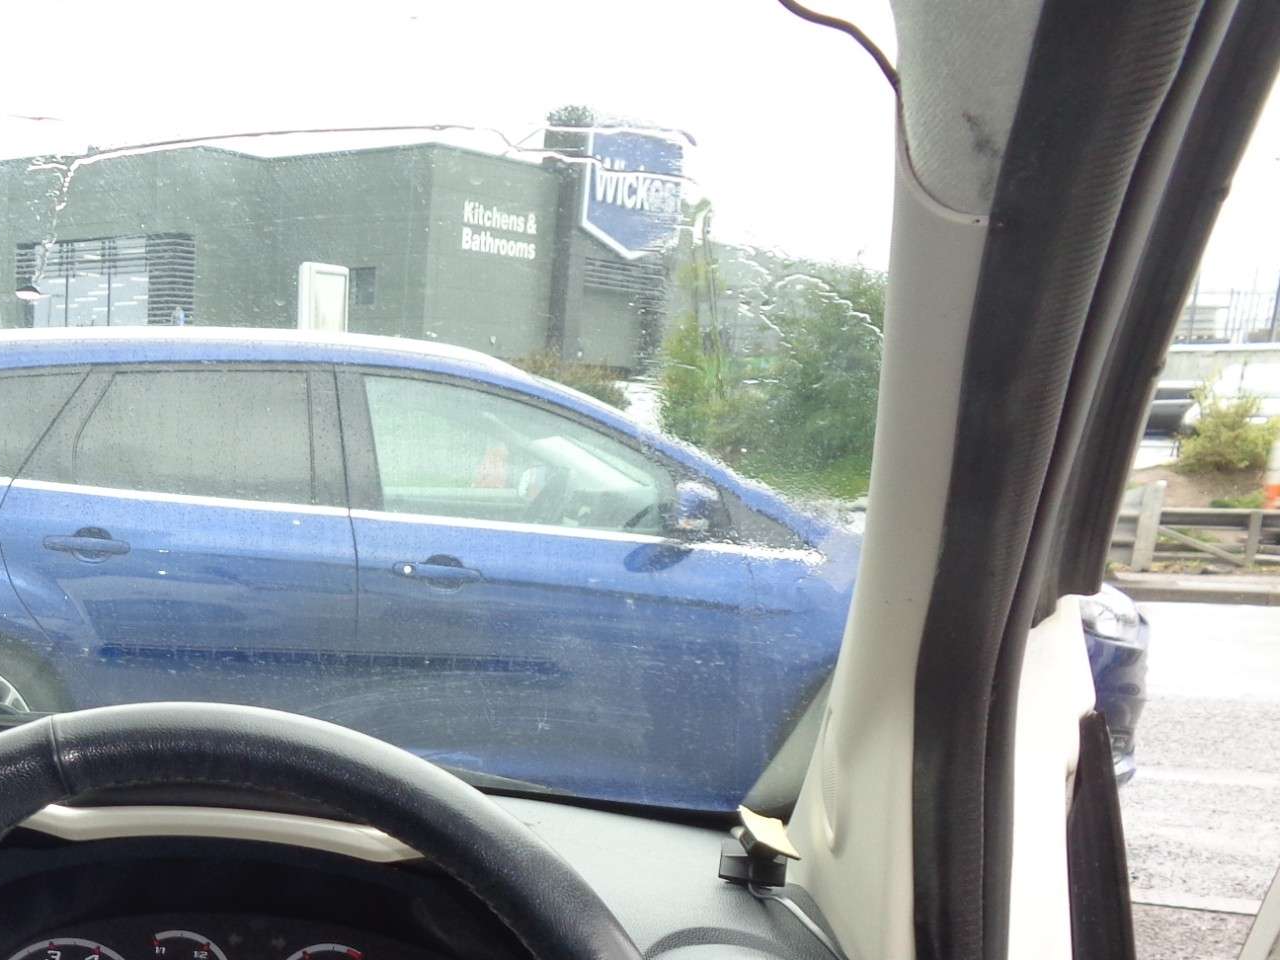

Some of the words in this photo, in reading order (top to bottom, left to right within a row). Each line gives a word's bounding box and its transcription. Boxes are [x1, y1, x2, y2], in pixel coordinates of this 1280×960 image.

[463, 200, 525, 234] Kitchens
[526, 211, 537, 235] &
[461, 226, 536, 260] Bathrooms
